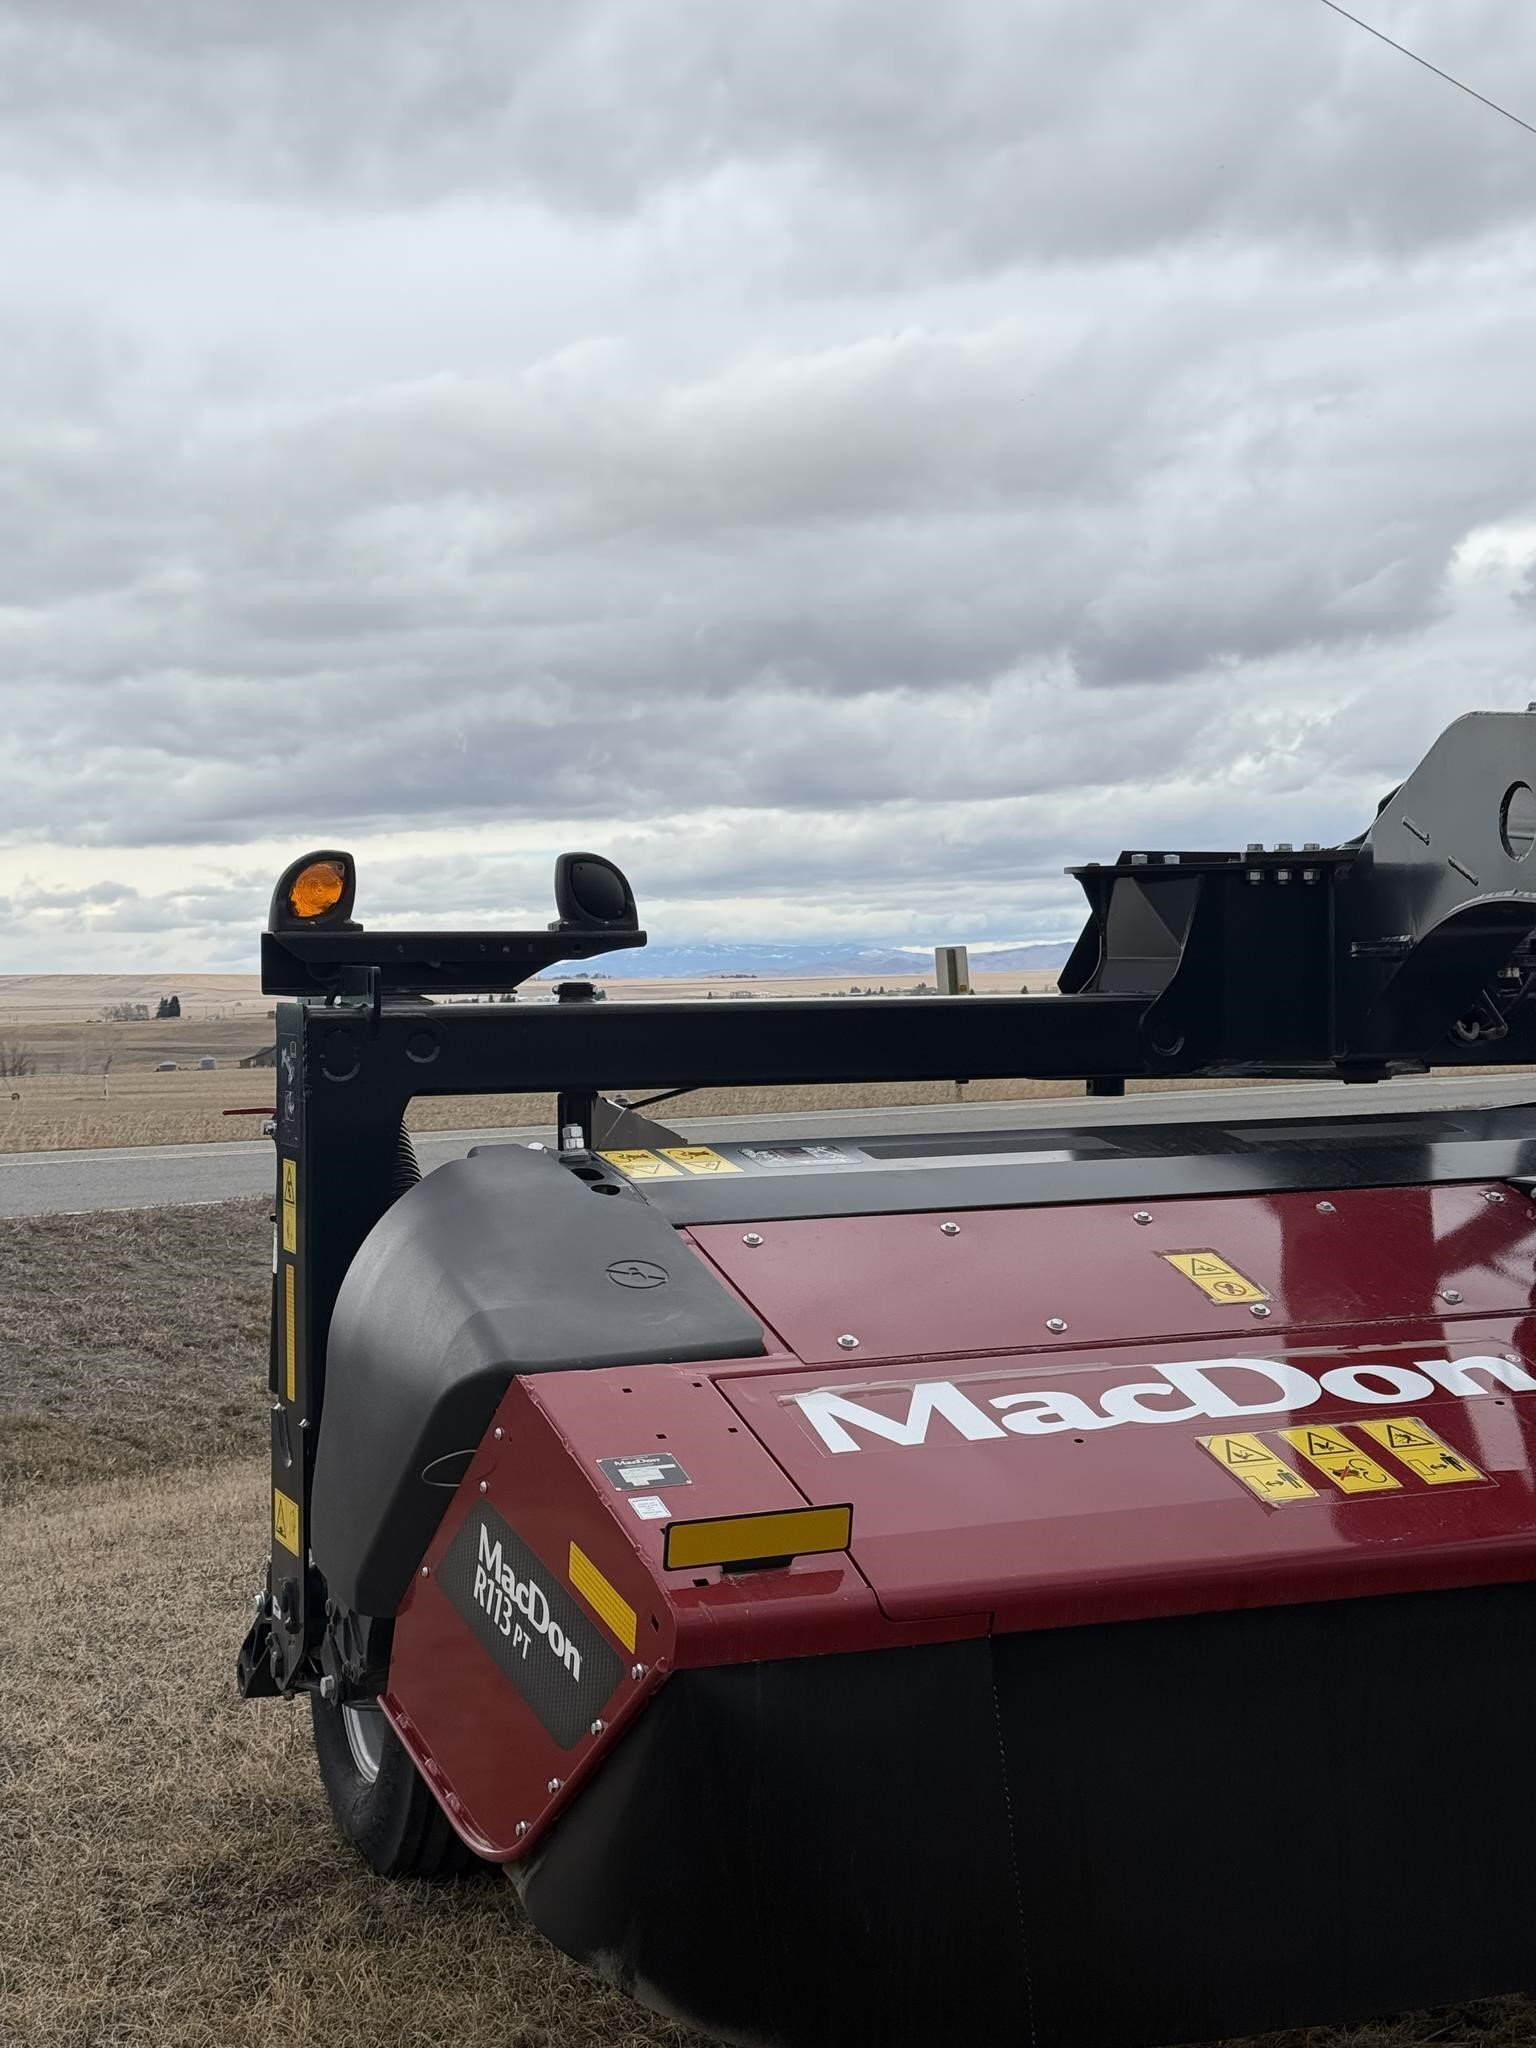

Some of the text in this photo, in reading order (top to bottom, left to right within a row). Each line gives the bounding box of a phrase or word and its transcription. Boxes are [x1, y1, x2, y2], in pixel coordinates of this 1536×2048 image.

[795, 1357, 1536, 1453] MacDon
[614, 1457, 661, 1467] MacDon
[473, 1565, 532, 1660] R113 PT
[478, 1522, 582, 1683] MacDon
